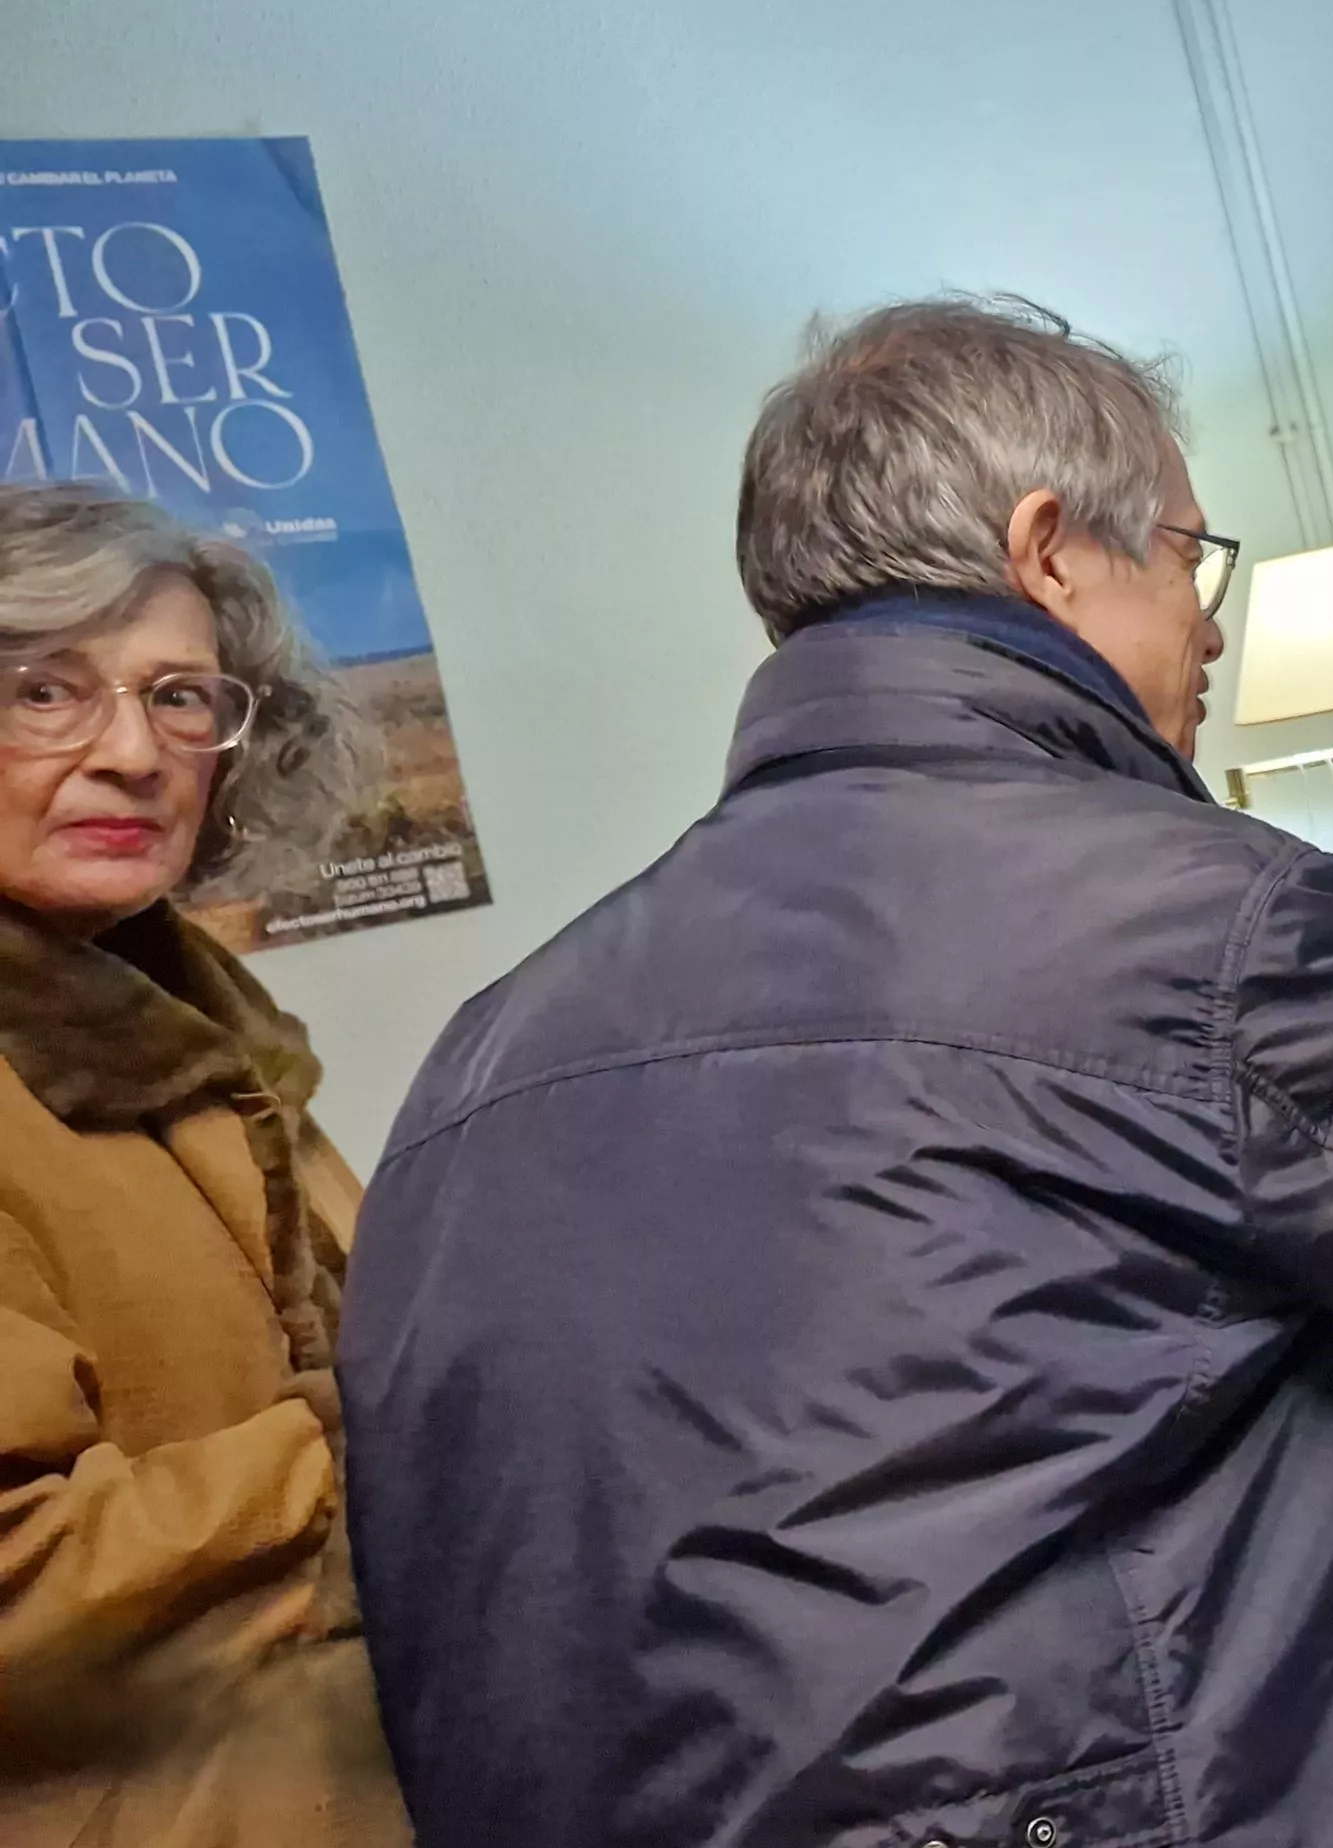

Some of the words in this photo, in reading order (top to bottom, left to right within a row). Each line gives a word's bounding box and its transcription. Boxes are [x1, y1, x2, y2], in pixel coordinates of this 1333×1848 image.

[105, 169, 178, 184] PLANETA
[0, 221, 202, 318] TO
[71, 311, 294, 410] SER
